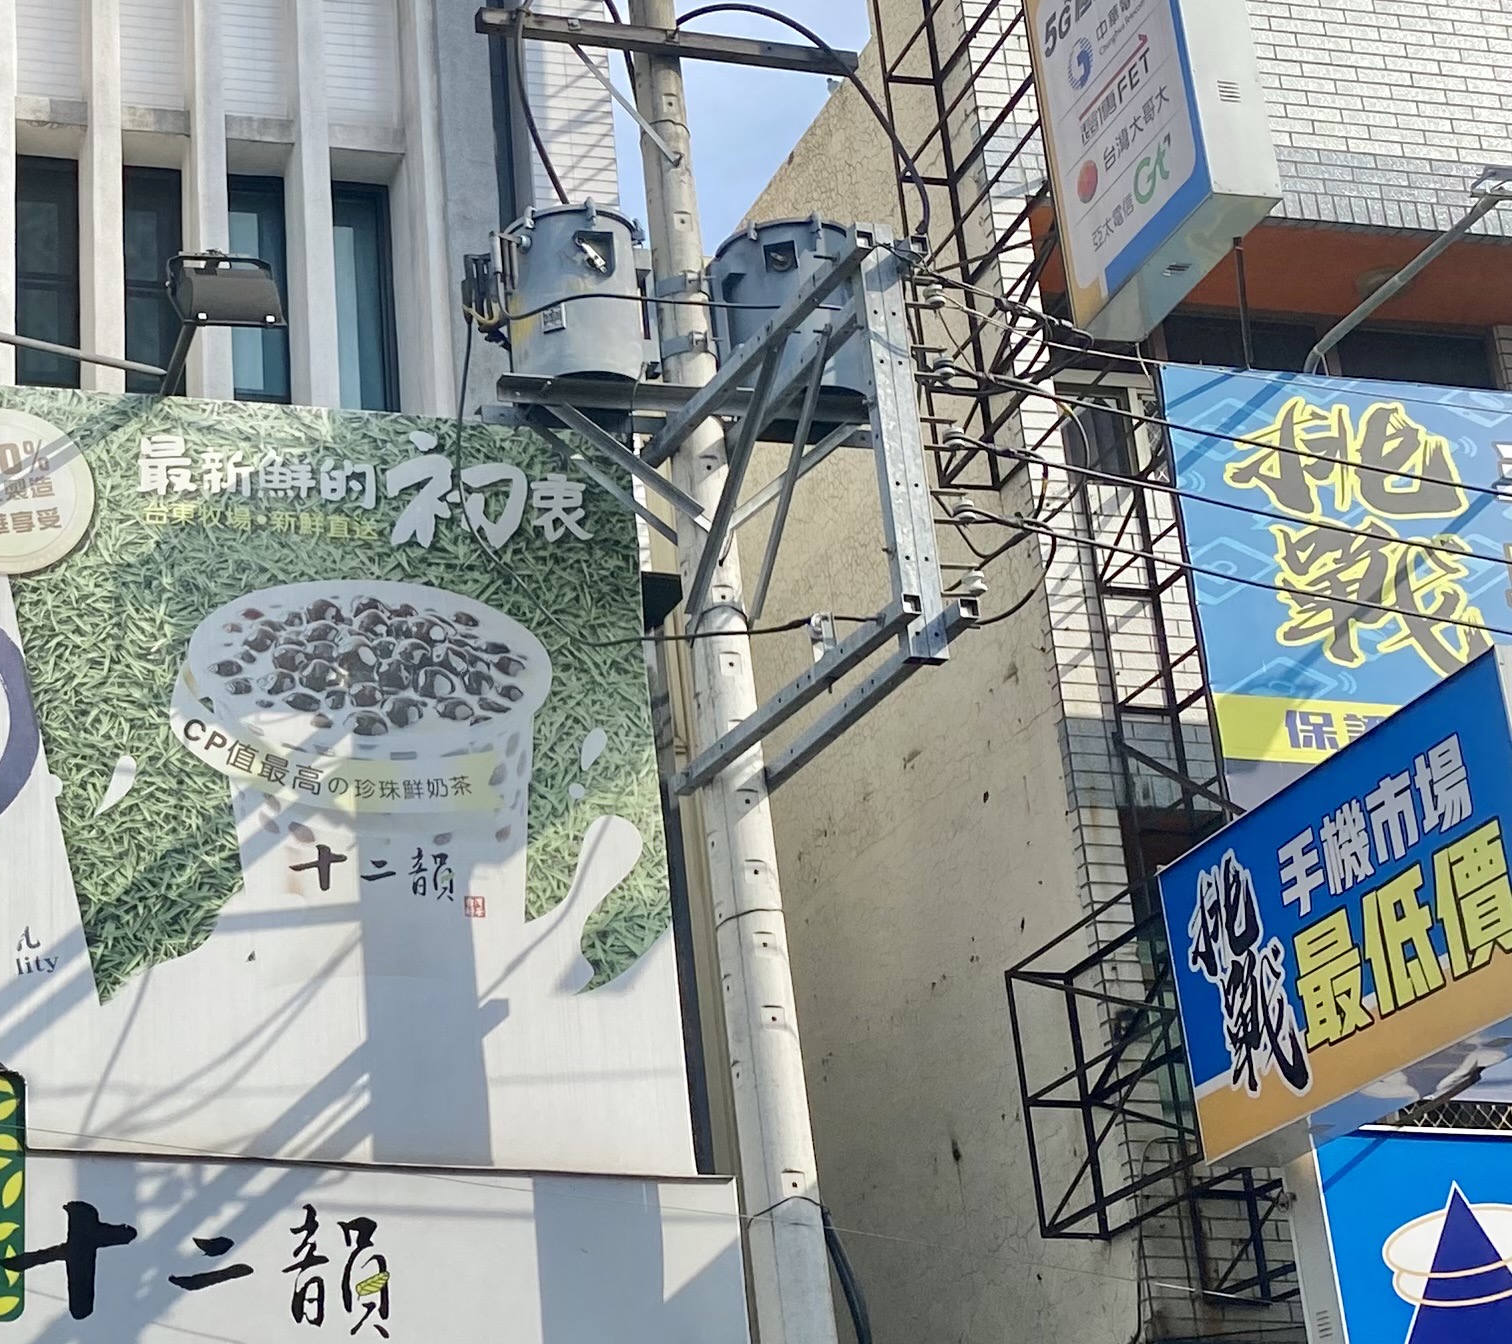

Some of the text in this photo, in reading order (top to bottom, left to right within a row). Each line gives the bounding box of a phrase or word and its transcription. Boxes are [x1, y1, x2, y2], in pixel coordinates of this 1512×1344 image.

[1103, 85, 1170, 173] 台灣大哥大
[1091, 192, 1136, 252] 亞太電信
[136, 432, 594, 549] 最新鮮的初衷
[182, 717, 474, 800] CP值最高の珍珠鮮奶茶
[289, 844, 456, 903] 十二韻
[1278, 732, 1473, 916] 手機市場
[1188, 848, 1312, 1097] 挑戰
[1294, 818, 1512, 1053] 最低價
[2, 1200, 393, 1341] 十二韻
